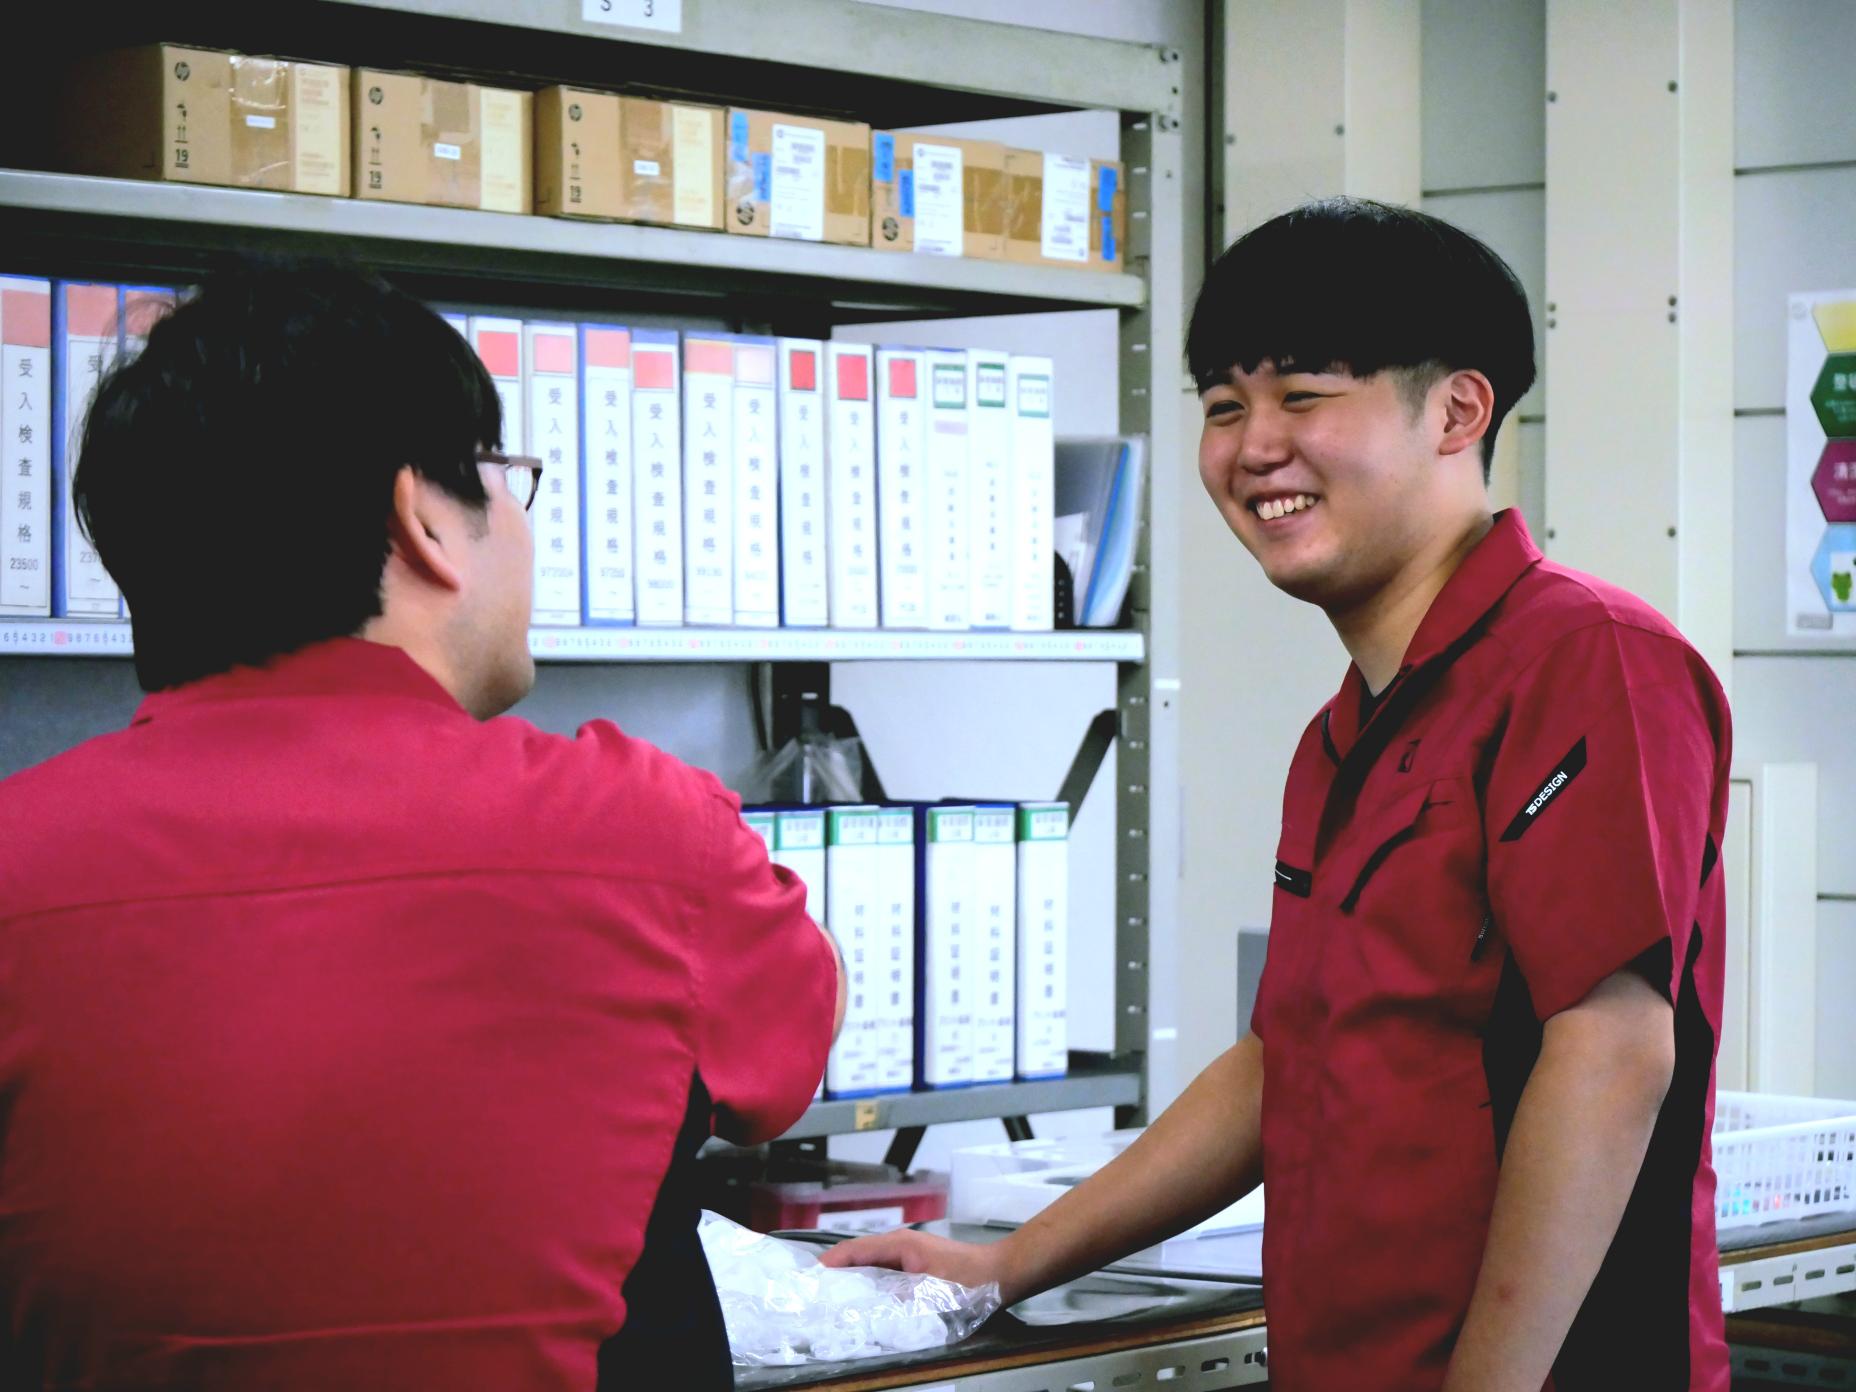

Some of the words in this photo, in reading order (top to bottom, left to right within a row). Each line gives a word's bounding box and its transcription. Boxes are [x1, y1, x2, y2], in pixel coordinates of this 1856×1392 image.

[17, 358, 33, 543] 受入検査規格
